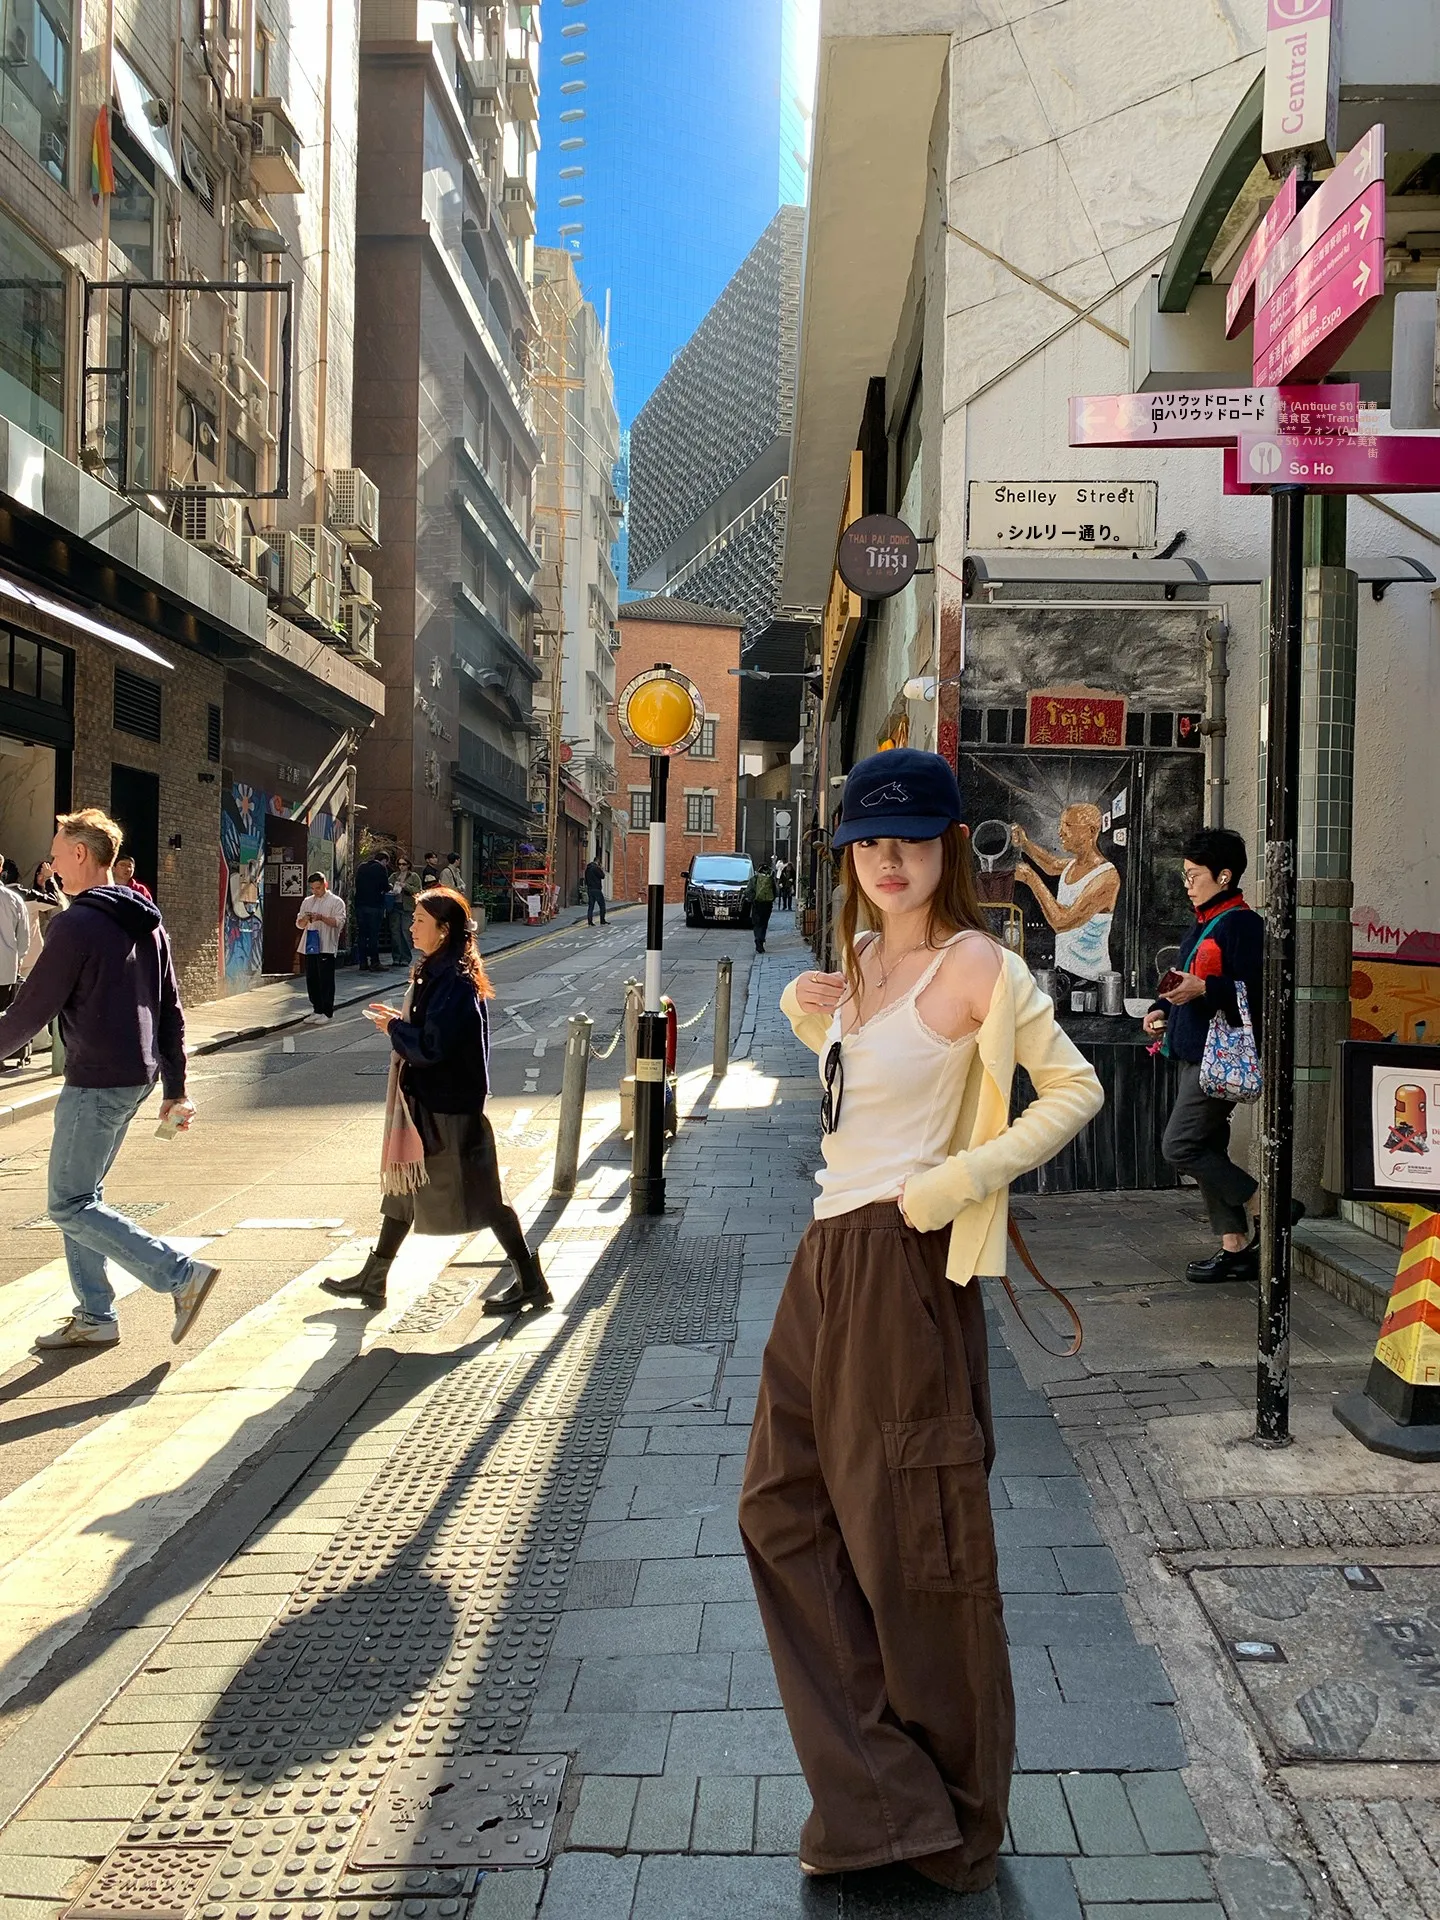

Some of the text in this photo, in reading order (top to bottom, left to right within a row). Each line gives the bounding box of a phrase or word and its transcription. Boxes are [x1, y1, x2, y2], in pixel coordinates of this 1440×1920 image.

[1281, 31, 1308, 134] Central
[1269, 363, 1282, 384] Hong
[1283, 345, 1300, 368] Kong
[1301, 306, 1342, 351] News-Expo
[994, 487, 1135, 506] Shelley Street
[848, 533, 910, 545] THAI PAI DONG
[1377, 1341, 1407, 1374] FEHD
[1425, 1366, 1440, 1382] F
